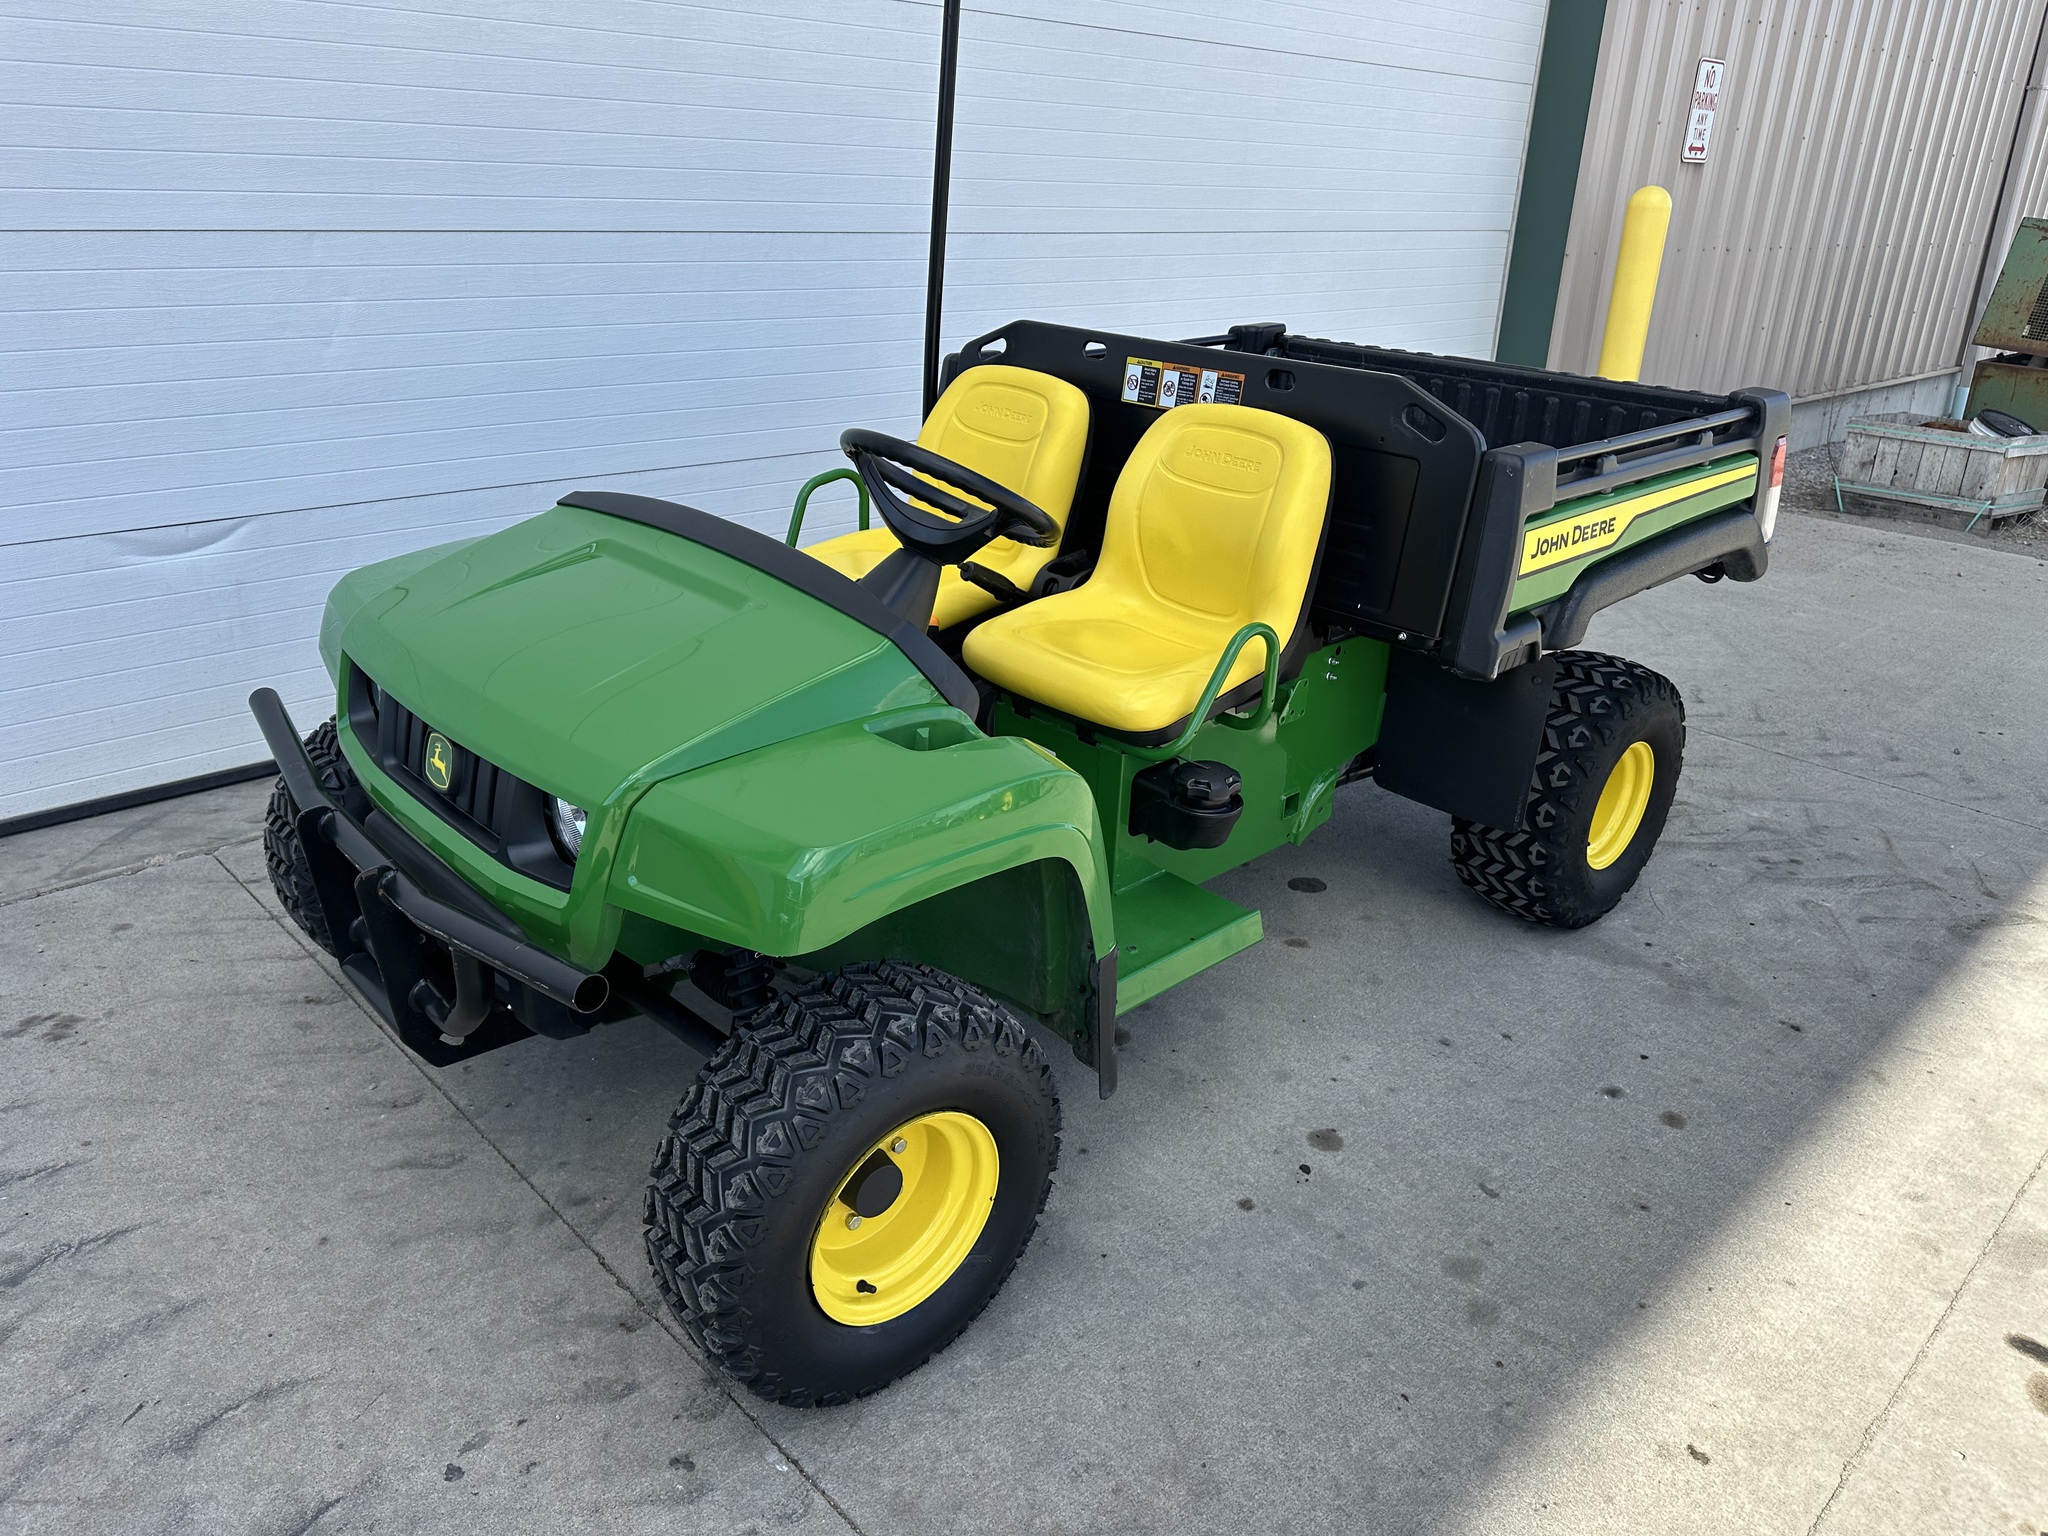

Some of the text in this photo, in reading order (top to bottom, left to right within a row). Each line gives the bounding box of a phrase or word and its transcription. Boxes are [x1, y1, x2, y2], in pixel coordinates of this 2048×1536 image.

[1704, 69, 1716, 88] NO
[1693, 91, 1718, 111] PARKING
[1697, 113, 1708, 125] ANY
[1693, 127, 1706, 140] TIME
[974, 401, 1033, 425] JOHN DEERE
[1184, 445, 1262, 473] JOHN DEERE
[1531, 517, 1616, 559] JOHN DEERE
